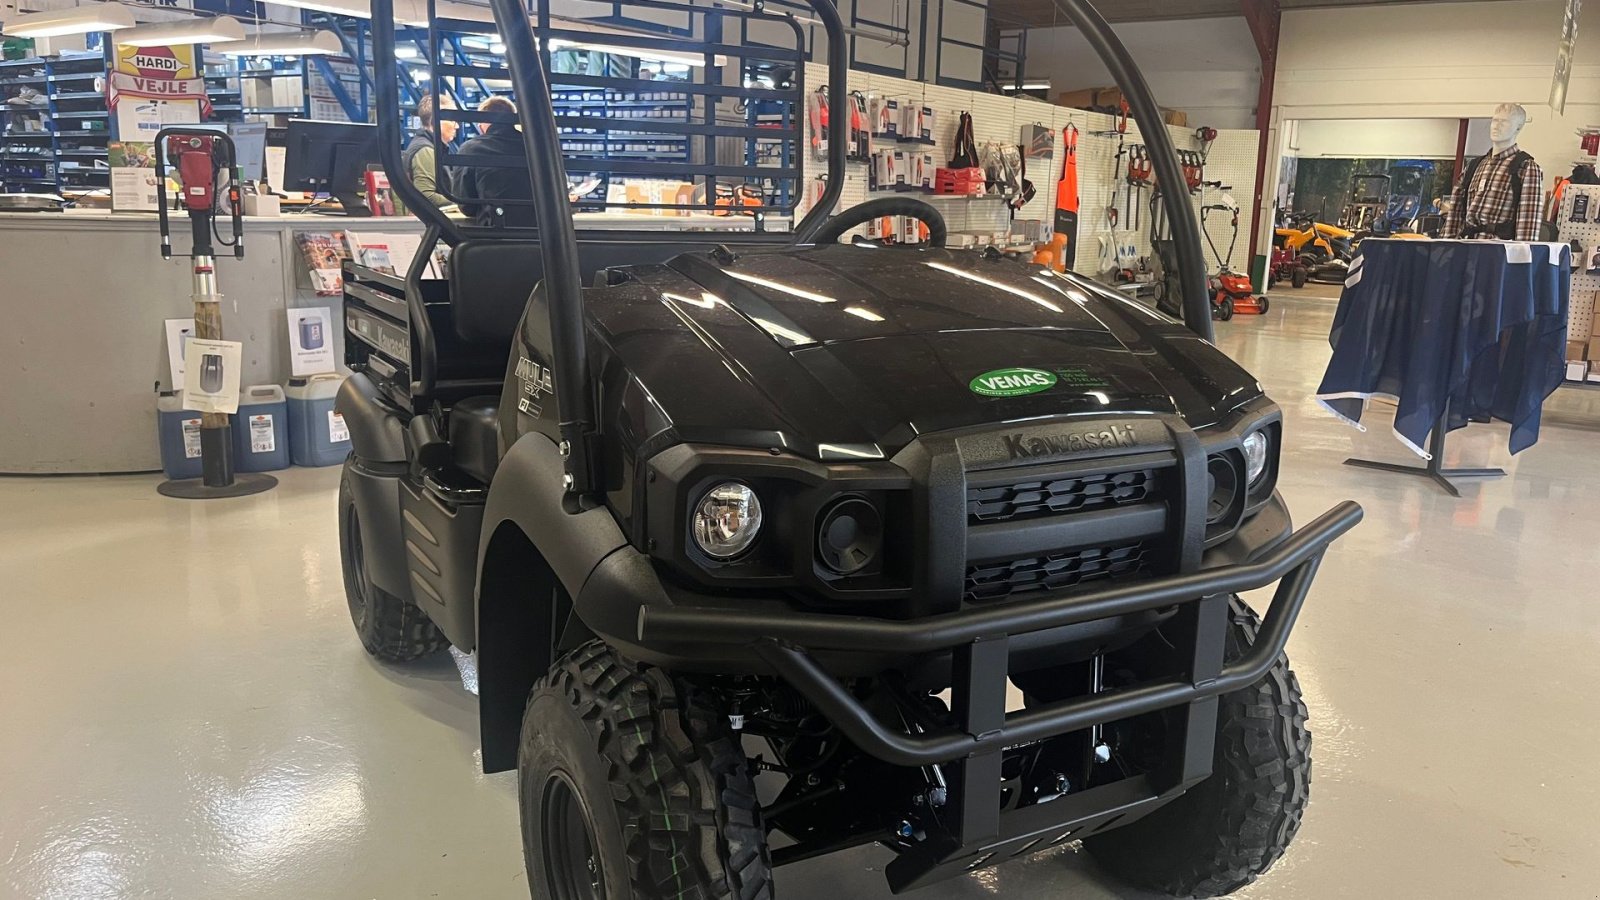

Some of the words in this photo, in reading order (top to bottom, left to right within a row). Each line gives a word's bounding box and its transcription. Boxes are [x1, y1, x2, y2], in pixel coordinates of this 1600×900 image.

[136, 56, 177, 69] HARDI
[133, 77, 188, 94] VEJLE
[515, 356, 553, 394] MULE
[979, 373, 1049, 389] VEMAS
[524, 381, 540, 399] SX
[1002, 425, 1136, 459] Kawasaki
